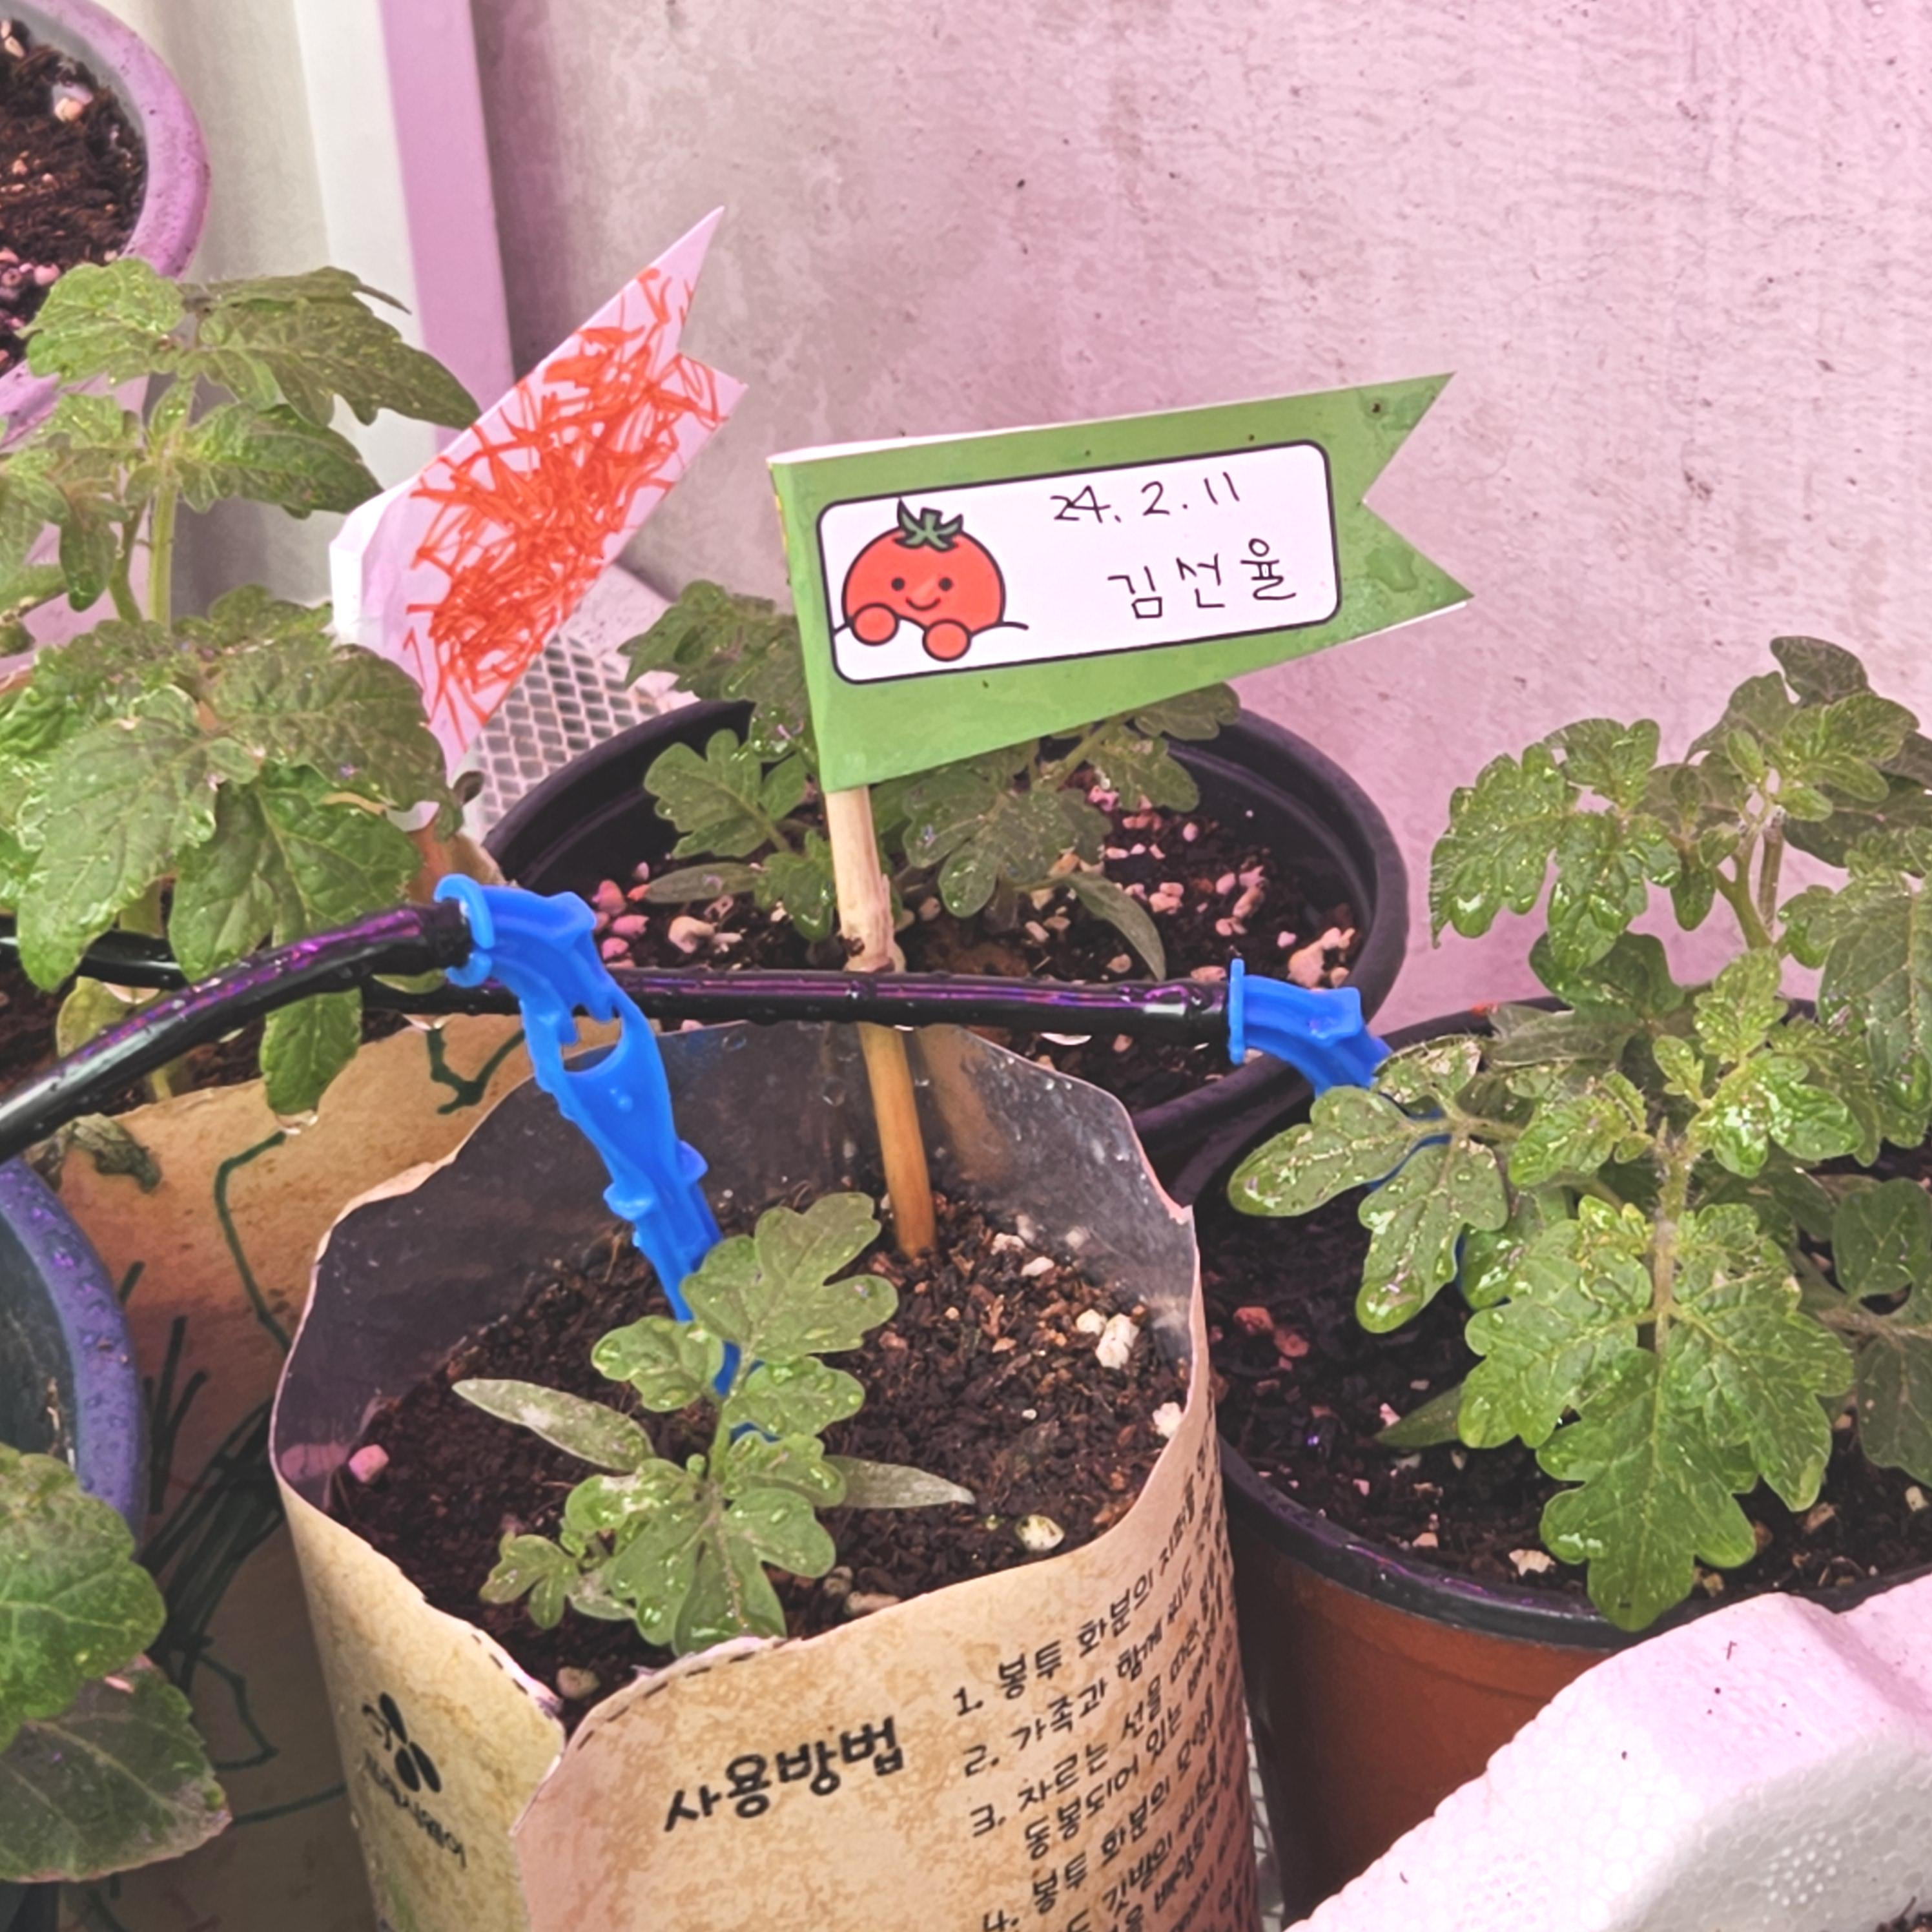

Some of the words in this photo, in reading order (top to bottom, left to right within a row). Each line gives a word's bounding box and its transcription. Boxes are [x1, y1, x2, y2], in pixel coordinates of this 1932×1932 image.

[952, 1686, 984, 1717] 1.
[998, 1640, 1063, 1700] 봉투
[1077, 1567, 1154, 1658] 화분의
[963, 1745, 1000, 1777] 2.
[1011, 1678, 1107, 1751] 가족과
[1116, 1616, 1162, 1680] 함께
[663, 1715, 904, 1833] 사용방법
[970, 1803, 1007, 1838] 3.
[1018, 1742, 1109, 1811] 자르는
[1121, 1674, 1161, 1741] 선을
[1024, 1762, 1139, 1861] 동봉되어
[1146, 1702, 1182, 1766] 있는
[1033, 1851, 1088, 1916] 봉투
[1100, 1774, 1171, 1868] 화분의
[1102, 1829, 1172, 1918] 깃발의
